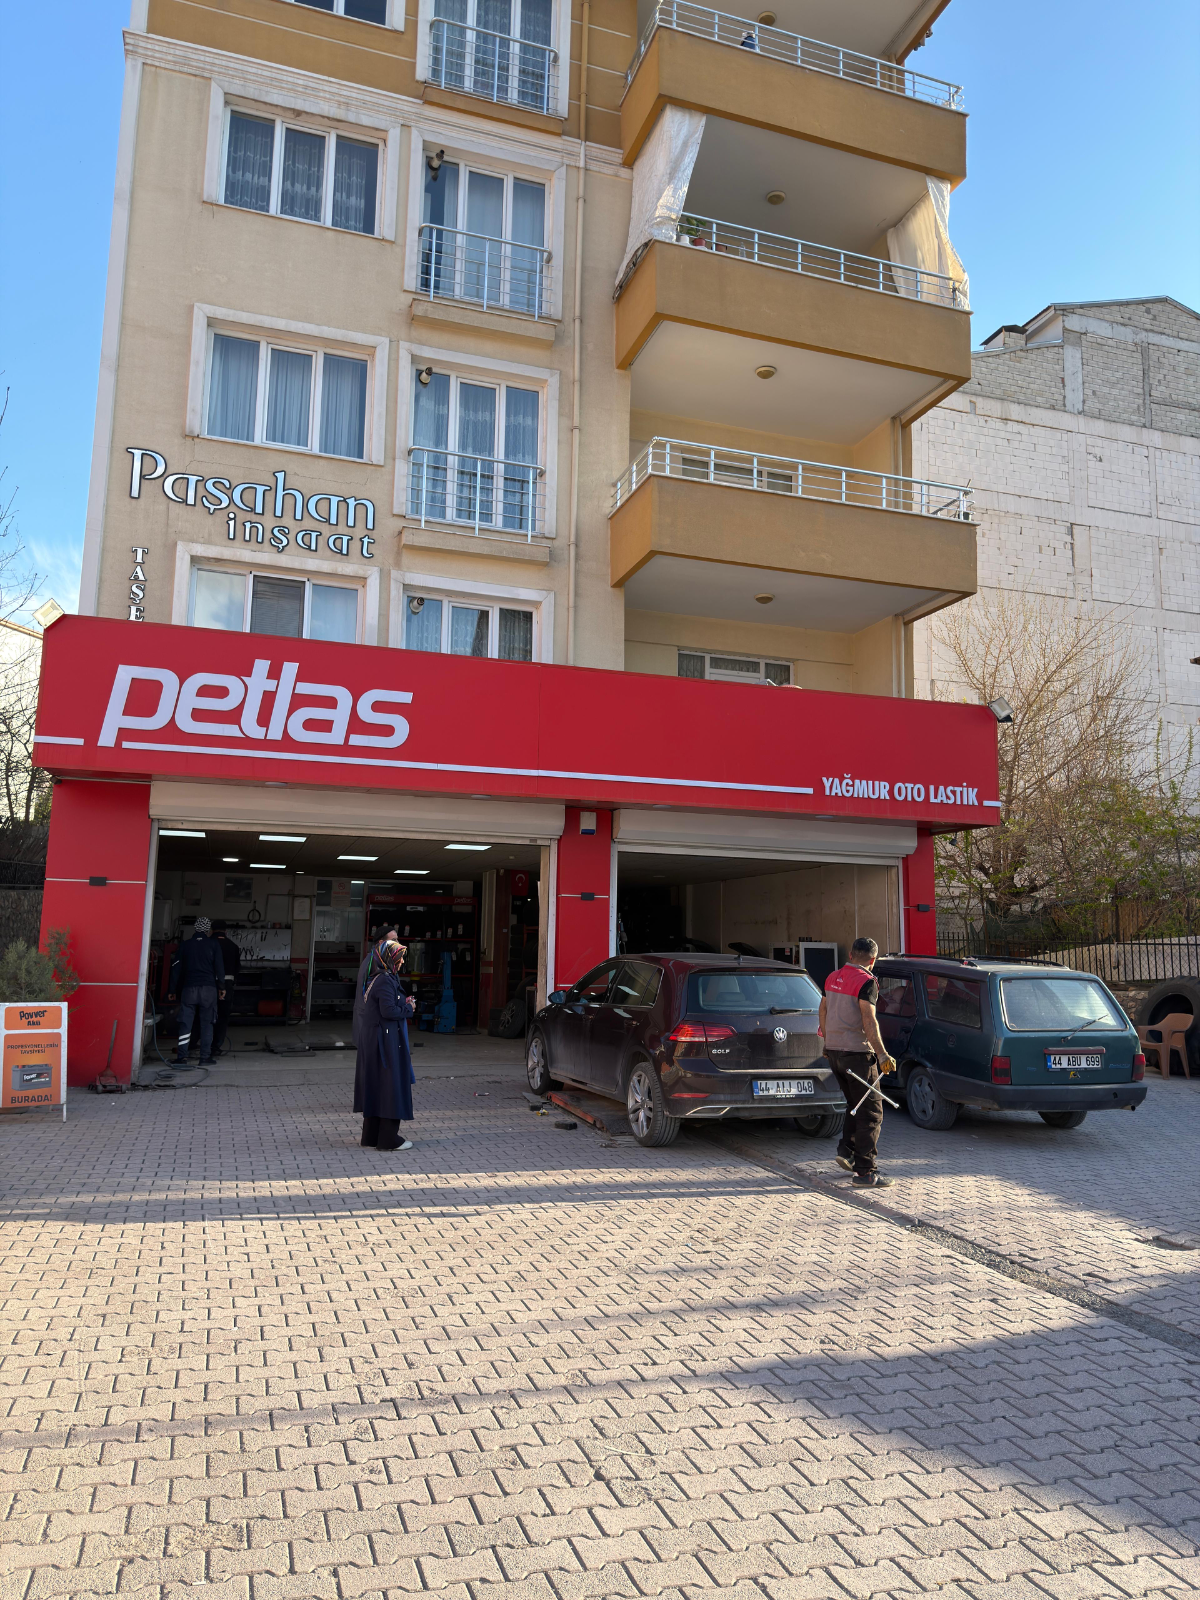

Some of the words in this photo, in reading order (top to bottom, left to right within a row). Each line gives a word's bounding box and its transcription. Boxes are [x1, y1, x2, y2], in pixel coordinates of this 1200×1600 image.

[126, 447, 375, 530] Paşahan
[227, 512, 375, 558] inşaat
[97, 658, 414, 749] petlas
[822, 773, 890, 800] YAĞMUR
[893, 782, 925, 802] OTO
[929, 782, 979, 806] LASTİK
[1052, 1056, 1062, 1066] 44
[1067, 1056, 1081, 1066] ABU
[1085, 1056, 1100, 1066] 699
[10, 1094, 53, 1104] BURADA!
[760, 1082, 770, 1094] 44
[797, 1081, 813, 1093] 048
